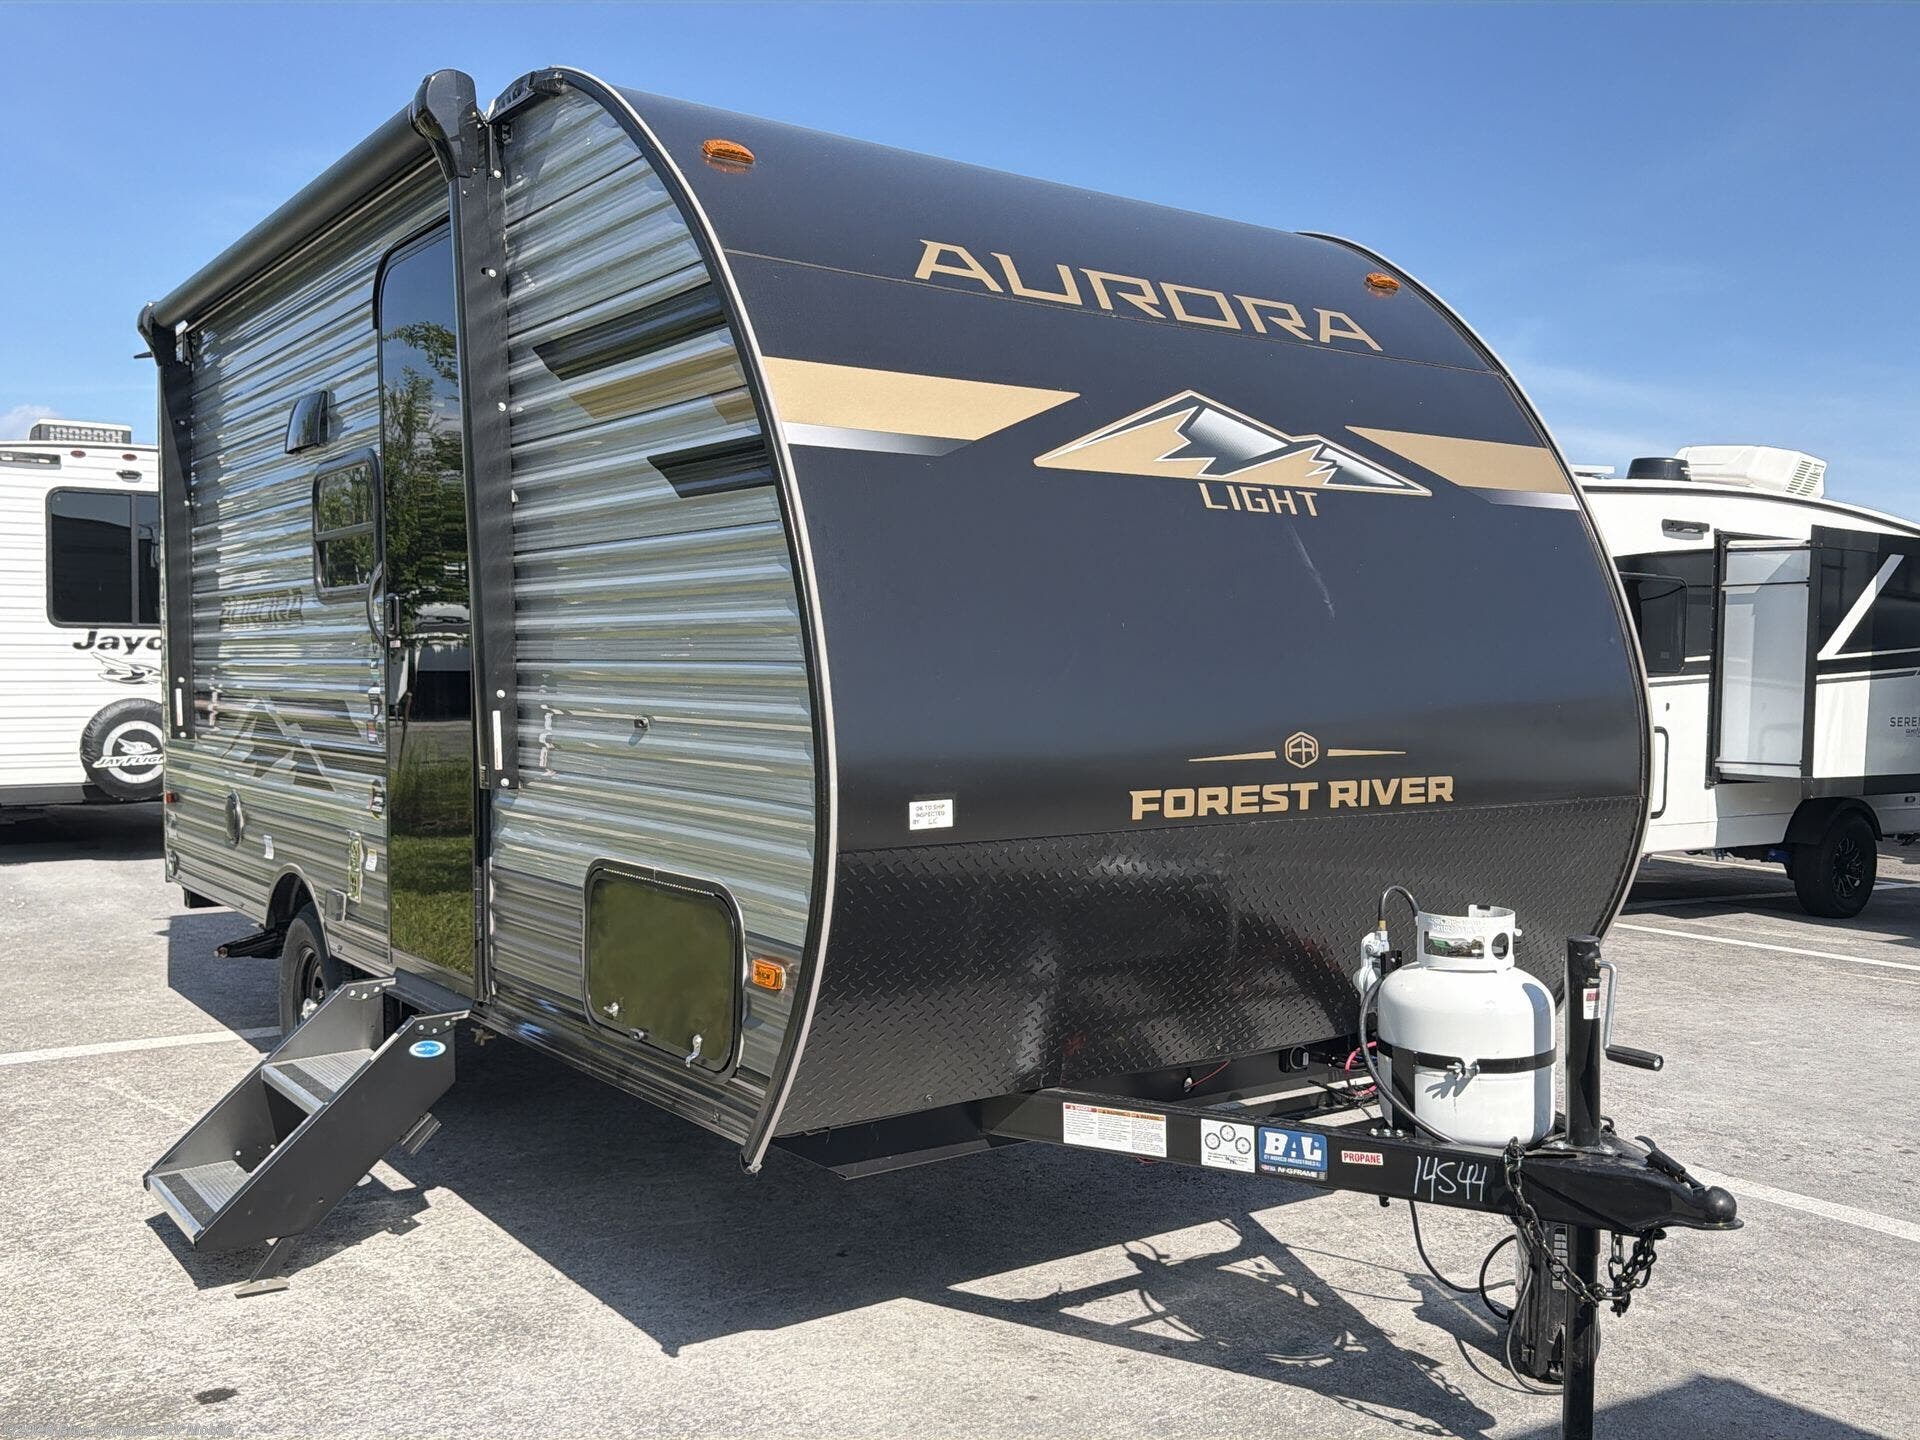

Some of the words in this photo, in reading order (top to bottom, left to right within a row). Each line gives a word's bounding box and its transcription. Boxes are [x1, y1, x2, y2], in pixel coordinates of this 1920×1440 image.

[914, 239, 1383, 352] AURORA
[1198, 483, 1317, 517] LIGHT
[1889, 716, 1920, 727] SERE
[1129, 781, 1319, 820] FOREST
[1327, 775, 1454, 808] RIVER
[1264, 1131, 1323, 1161] BAL
[1343, 1153, 1382, 1164] PROPANE
